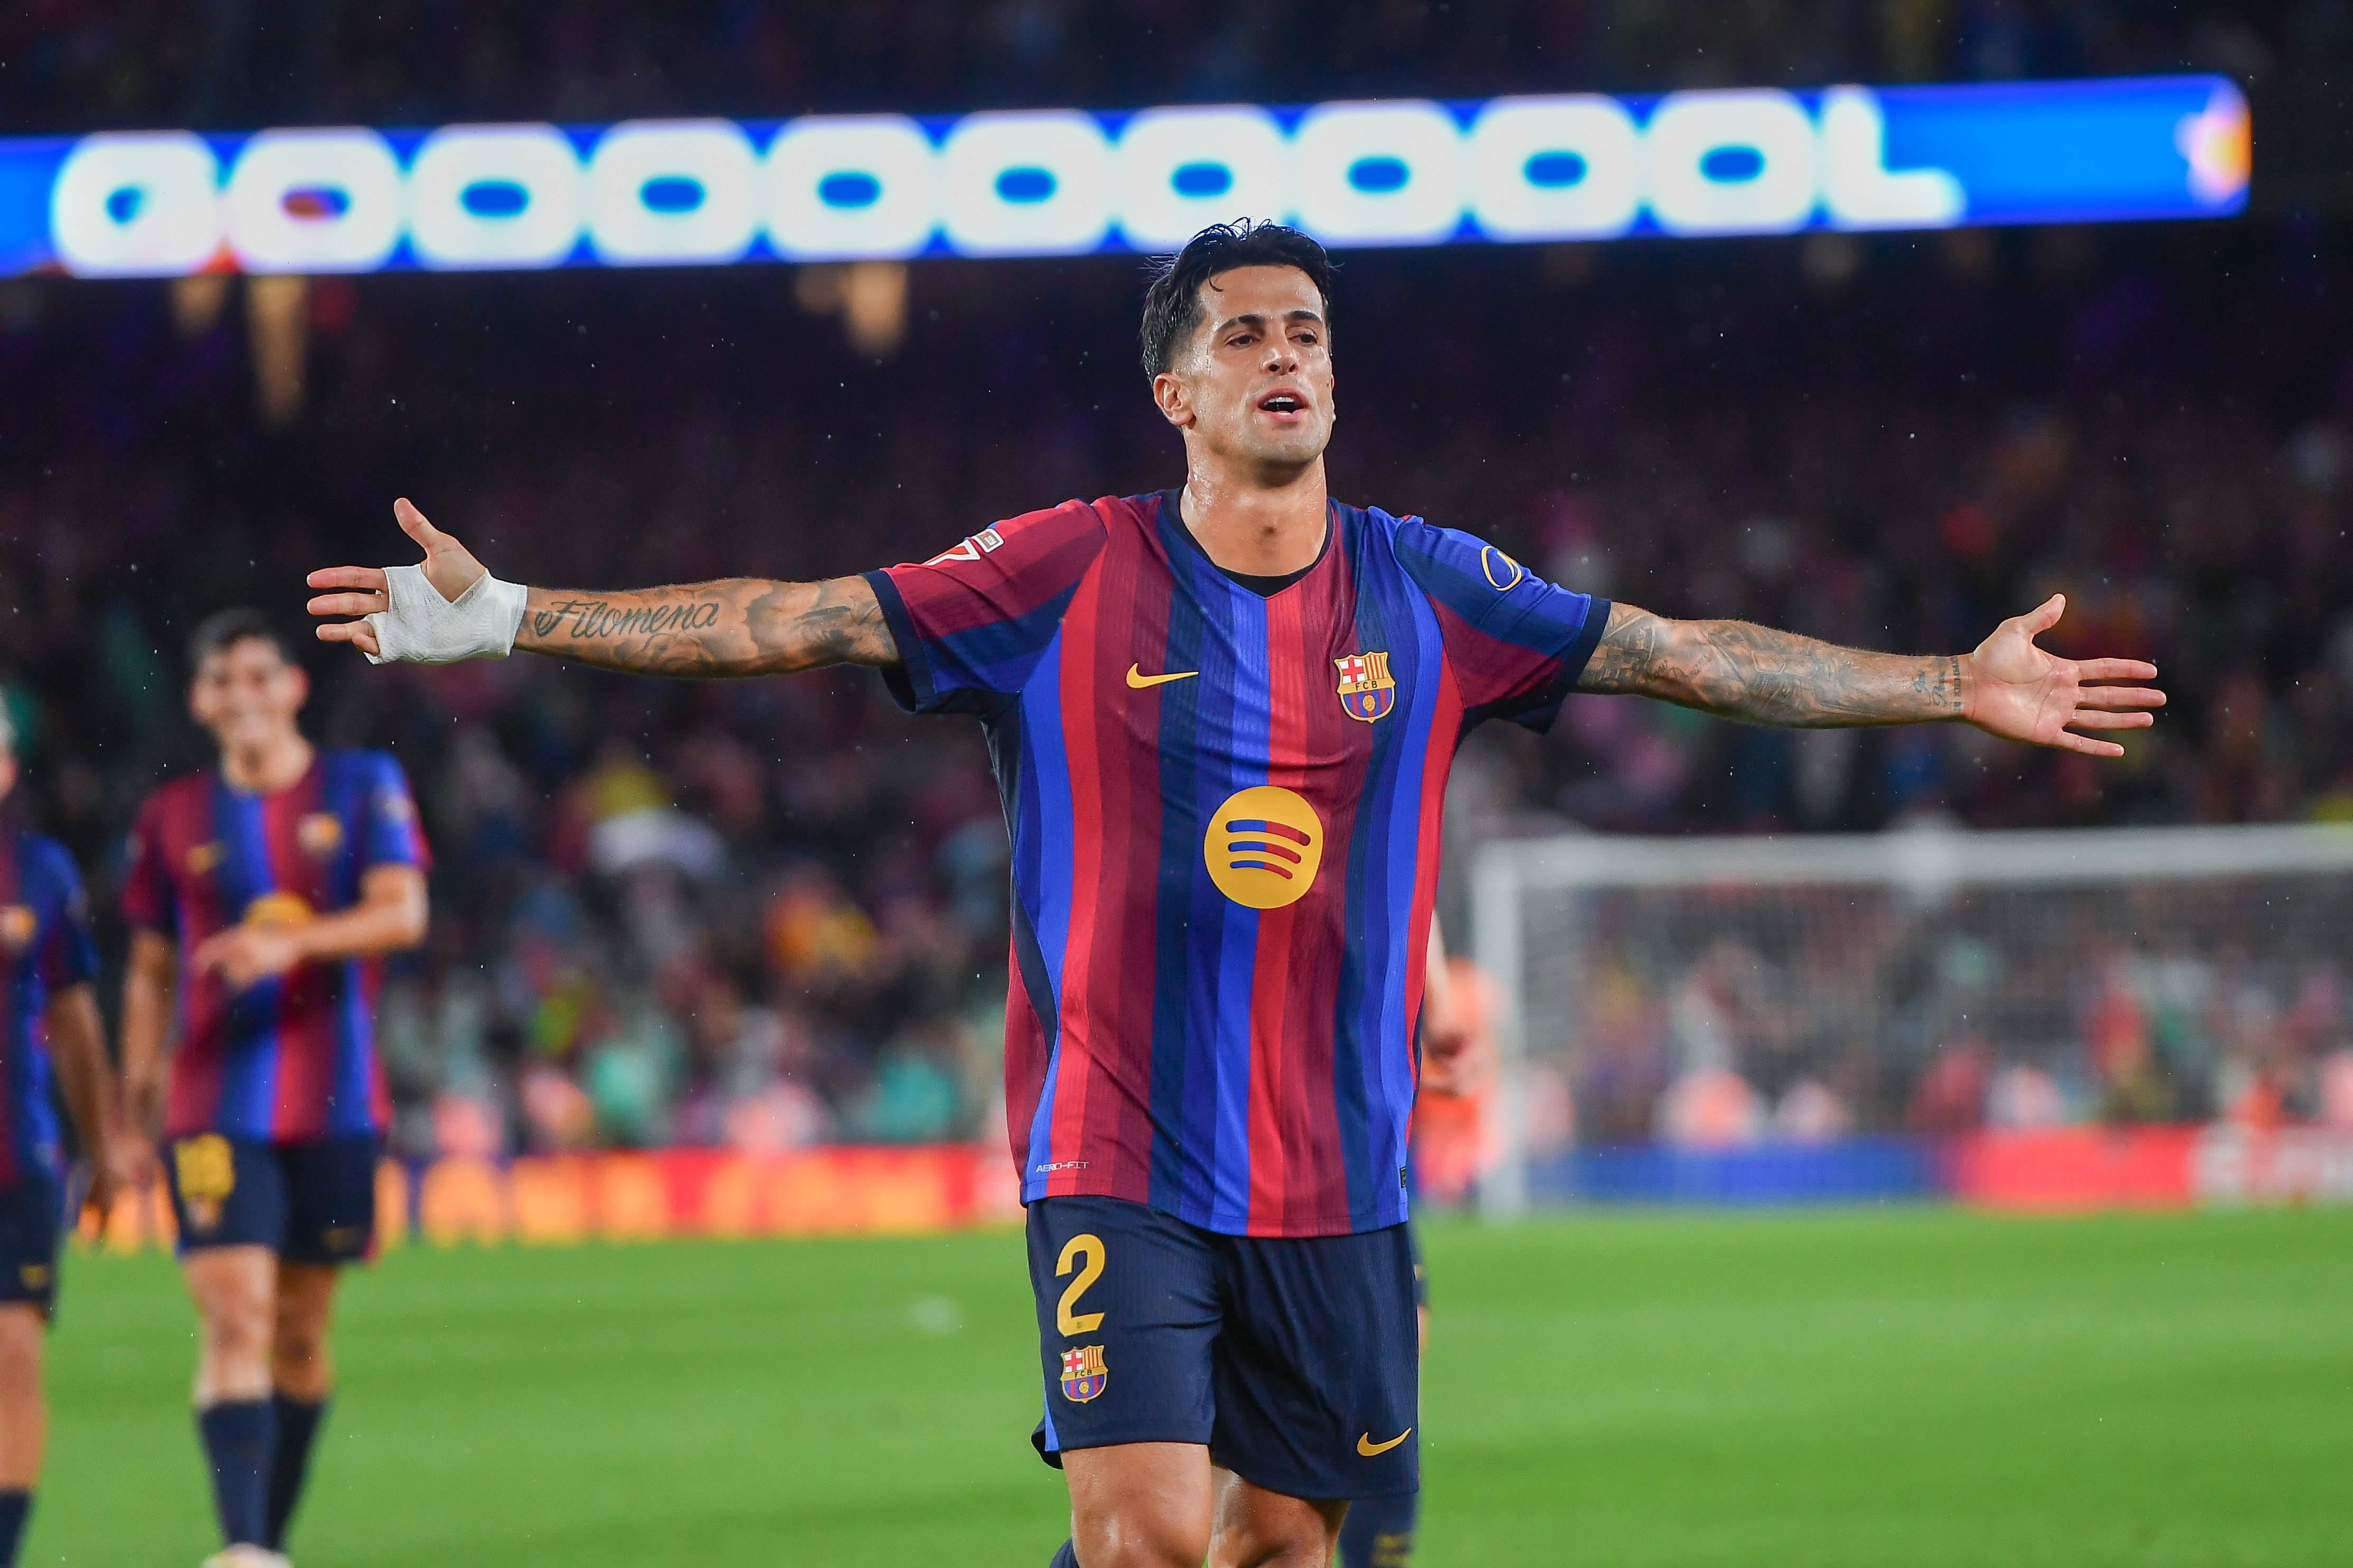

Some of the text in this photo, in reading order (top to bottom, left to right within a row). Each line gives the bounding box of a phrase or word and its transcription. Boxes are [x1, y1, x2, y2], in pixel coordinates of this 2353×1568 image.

[534, 599, 719, 638] Filomena
[1355, 681, 1378, 691] FCB
[1035, 1161, 1089, 1173] AERO-FIT
[1055, 1233, 1106, 1338] 2
[1075, 1369, 1092, 1378] FCB
